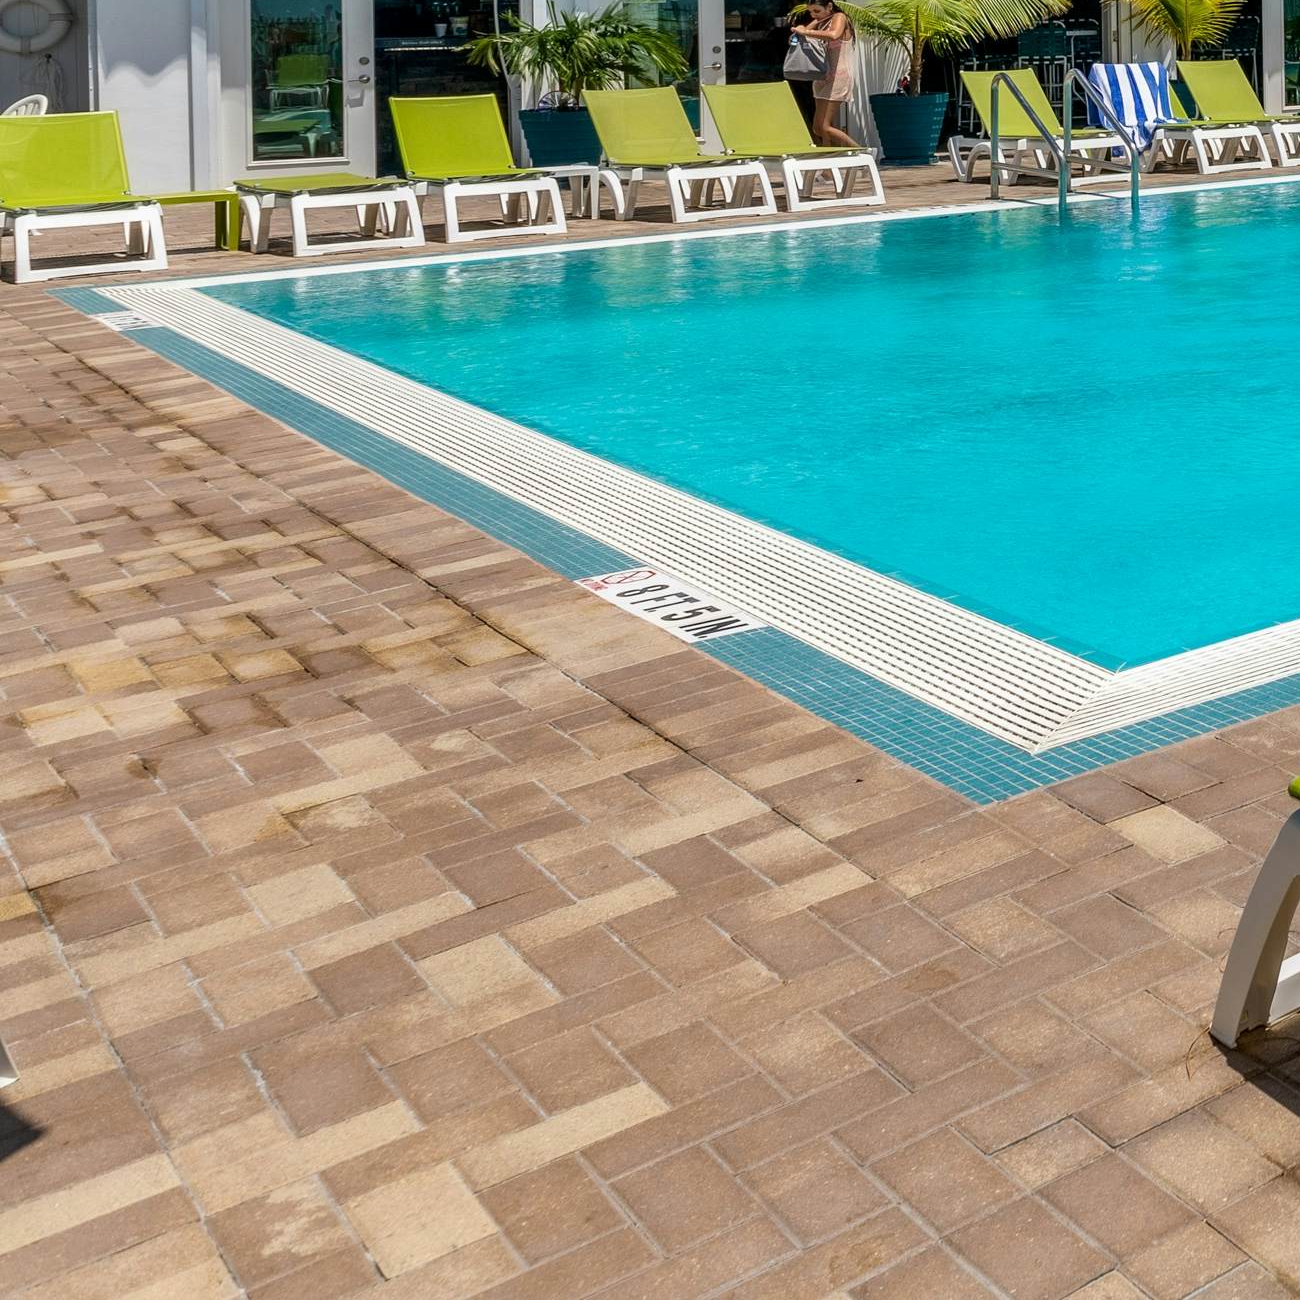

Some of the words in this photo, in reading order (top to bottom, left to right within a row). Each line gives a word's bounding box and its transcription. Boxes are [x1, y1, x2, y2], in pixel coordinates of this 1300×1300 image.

[616, 584, 670, 598] 8
[630, 592, 702, 612] FT.
[661, 605, 721, 621] 5
[679, 616, 748, 638] IN.
